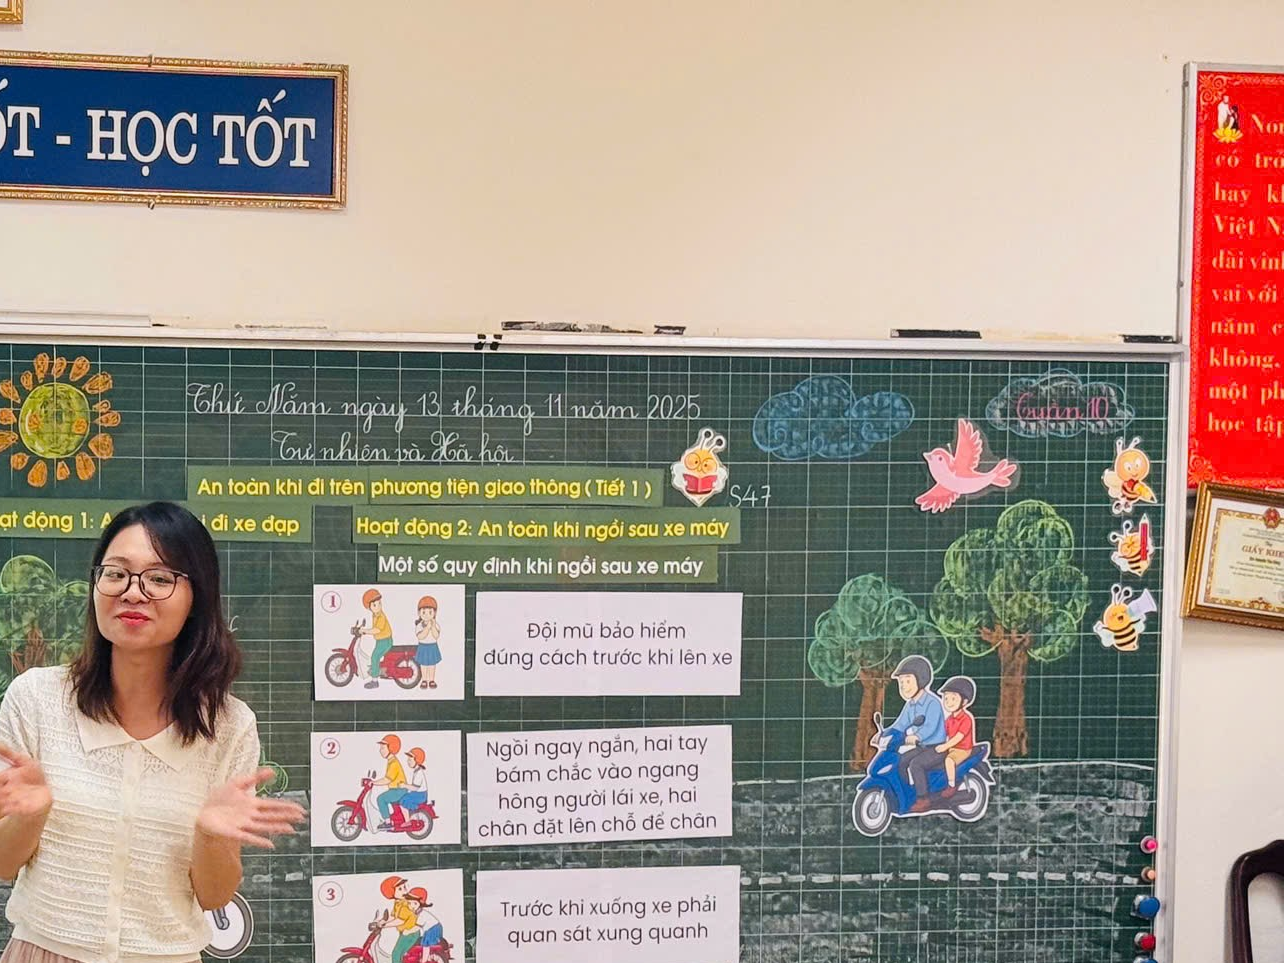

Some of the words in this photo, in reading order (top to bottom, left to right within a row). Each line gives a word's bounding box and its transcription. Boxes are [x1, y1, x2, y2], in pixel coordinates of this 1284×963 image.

[86, 108, 199, 178] HỌC
[212, 88, 317, 169] TỐT
[1215, 149, 1240, 168] có
[1214, 181, 1251, 207] hay
[1214, 214, 1255, 239] Việt
[1211, 248, 1244, 270] đài
[1211, 284, 1242, 303] vai
[1246, 284, 1277, 303] với
[1210, 317, 1256, 335] năm
[1209, 381, 1249, 405] một
[186, 382, 247, 415] Thứ
[255, 382, 332, 415] Năm
[340, 396, 409, 434] ngày
[416, 391, 441, 416] 13
[452, 385, 536, 435] tháng
[545, 393, 563, 418] 11
[569, 398, 640, 419] năm
[647, 394, 701, 420] 2025
[1087, 396, 1109, 420] 10
[1207, 411, 1245, 437] học
[319, 431, 392, 461] nhiên
[394, 442, 426, 462] và
[478, 432, 515, 467] hội
[196, 478, 223, 496] An
[227, 477, 270, 496] toàn
[275, 478, 303, 496] khi
[307, 478, 325, 496] đi
[329, 477, 365, 496] trên
[370, 478, 442, 499] phương
[446, 478, 480, 498] tiện
[484, 479, 526, 499] giao
[529, 478, 581, 498] thông
[22, 511, 74, 533] động
[80, 511, 95, 530] 1:
[210, 514, 229, 531] đi
[233, 518, 257, 532] xe
[261, 515, 301, 536] đạp
[356, 516, 401, 538] Hoạt
[404, 518, 453, 541] động
[457, 519, 473, 537] 2:
[477, 519, 504, 537] An
[507, 519, 549, 538] toàn
[553, 521, 581, 538] khi
[584, 518, 625, 542] ngồi
[628, 523, 660, 538] sau
[663, 522, 686, 537] xe
[689, 517, 730, 539] máy
[378, 554, 414, 576] Một
[417, 554, 439, 574] số
[442, 560, 478, 578] quy
[482, 556, 522, 577] định
[526, 556, 553, 575] khi
[557, 555, 597, 579] ngồi
[600, 560, 633, 575] sau
[636, 560, 660, 575] xe
[663, 556, 704, 578] máy
[327, 594, 338, 609] 1
[526, 621, 557, 642] Đội
[562, 622, 594, 640] mũ
[599, 620, 635, 640] bảo
[639, 619, 686, 640] hiểm
[482, 648, 534, 671] đúng
[538, 648, 587, 666] cách
[592, 648, 642, 666] trước
[647, 648, 674, 666] khi
[678, 648, 707, 666] lên
[712, 652, 733, 666] xe
[325, 741, 338, 755] 2
[485, 739, 529, 762] Ngồi
[533, 740, 583, 760] ngay
[587, 733, 640, 759] ngắn,
[643, 734, 673, 752] hai
[678, 735, 709, 756] tay
[495, 764, 541, 785] bám
[546, 761, 592, 783] chắc
[597, 763, 633, 780] vào
[637, 762, 699, 784] ngang
[497, 792, 548, 814] hông
[553, 789, 606, 813] người
[612, 788, 634, 806] lái
[638, 791, 664, 807] xe,
[668, 785, 698, 804] hai
[477, 819, 528, 838] chân
[532, 818, 564, 839] đặt
[569, 817, 597, 834] lên
[601, 811, 637, 833] chỗ
[641, 809, 666, 831] để
[669, 812, 717, 831] chân
[325, 886, 337, 903] 3
[500, 899, 554, 918] Trước
[558, 898, 585, 917] khi
[588, 895, 647, 920] xuống
[651, 901, 673, 915] xe
[677, 893, 717, 919] phải
[507, 927, 557, 949] quan
[562, 924, 593, 943] sát
[596, 927, 643, 946] xung
[648, 922, 709, 945] quanh
